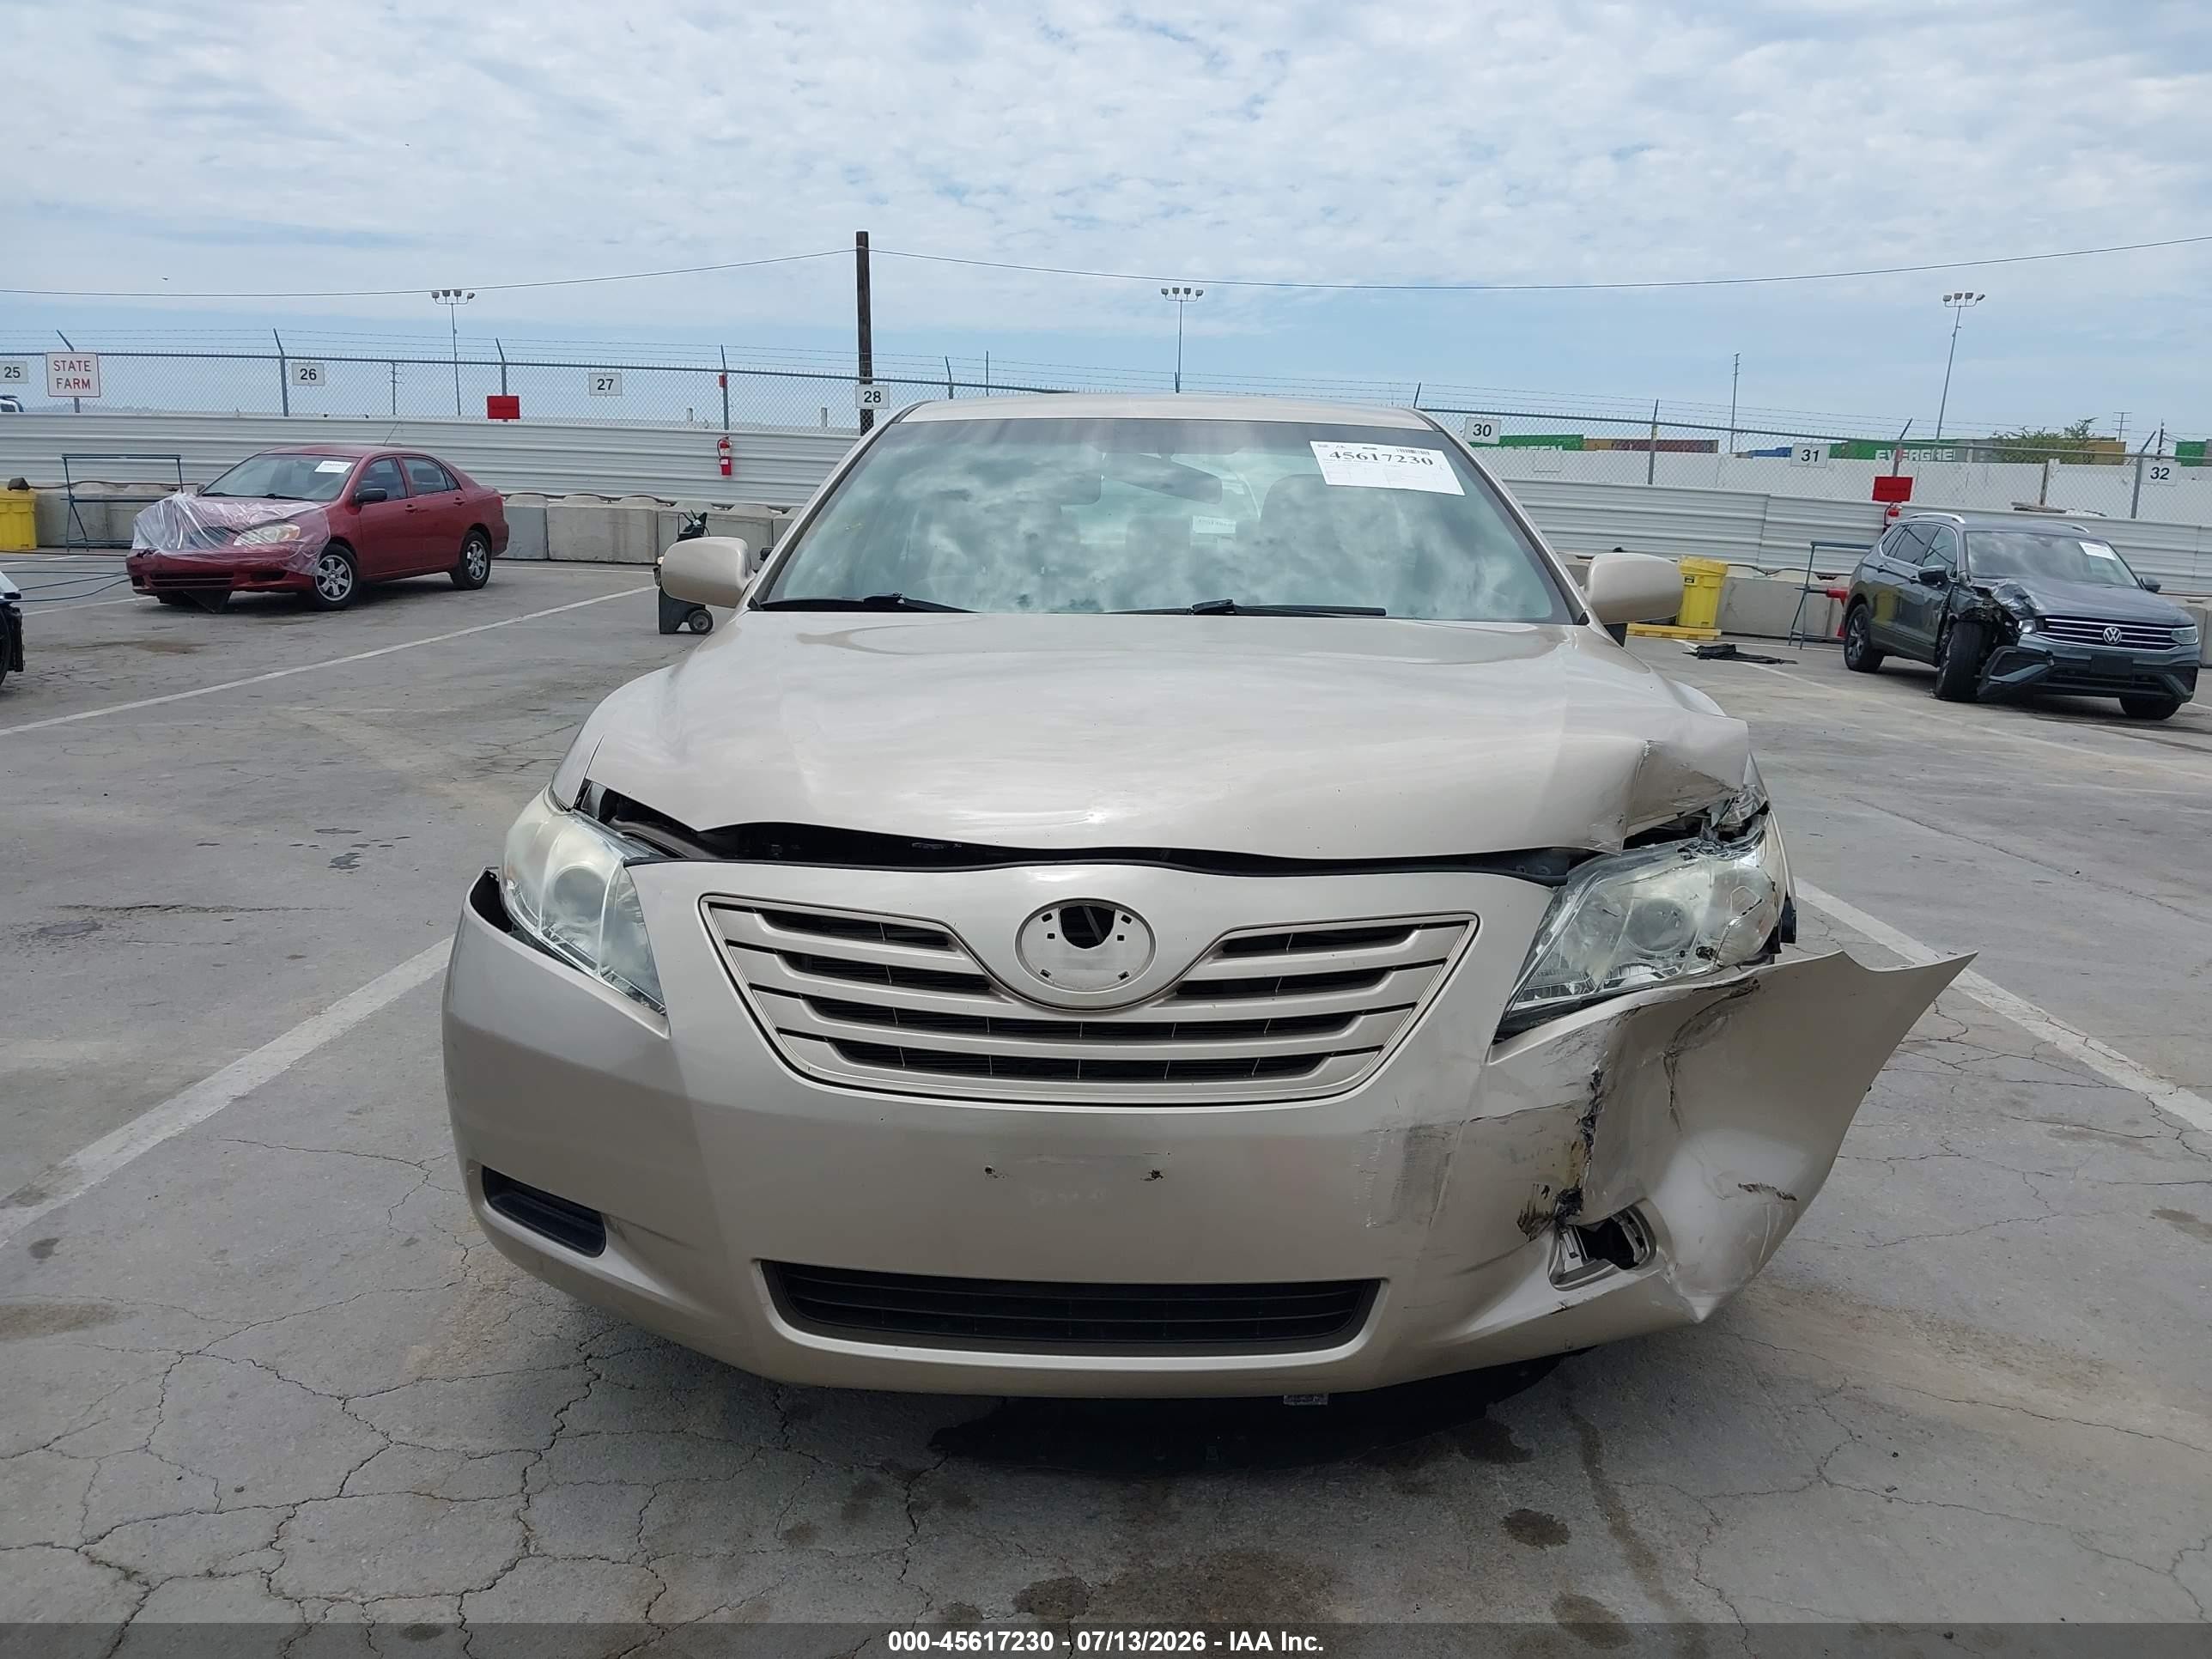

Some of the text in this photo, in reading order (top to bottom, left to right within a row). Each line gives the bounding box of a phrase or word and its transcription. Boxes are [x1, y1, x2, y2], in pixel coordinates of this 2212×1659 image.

[3, 366, 21, 379] 25
[53, 360, 91, 372] STATE
[300, 368, 317, 380] 26
[56, 378, 91, 390] FARM
[597, 378, 614, 391] 27
[864, 390, 882, 403] 28
[1472, 423, 1492, 437] 30
[1328, 451, 1434, 465] 45617230
[1801, 449, 1820, 462] 31
[2149, 466, 2171, 480] 32
